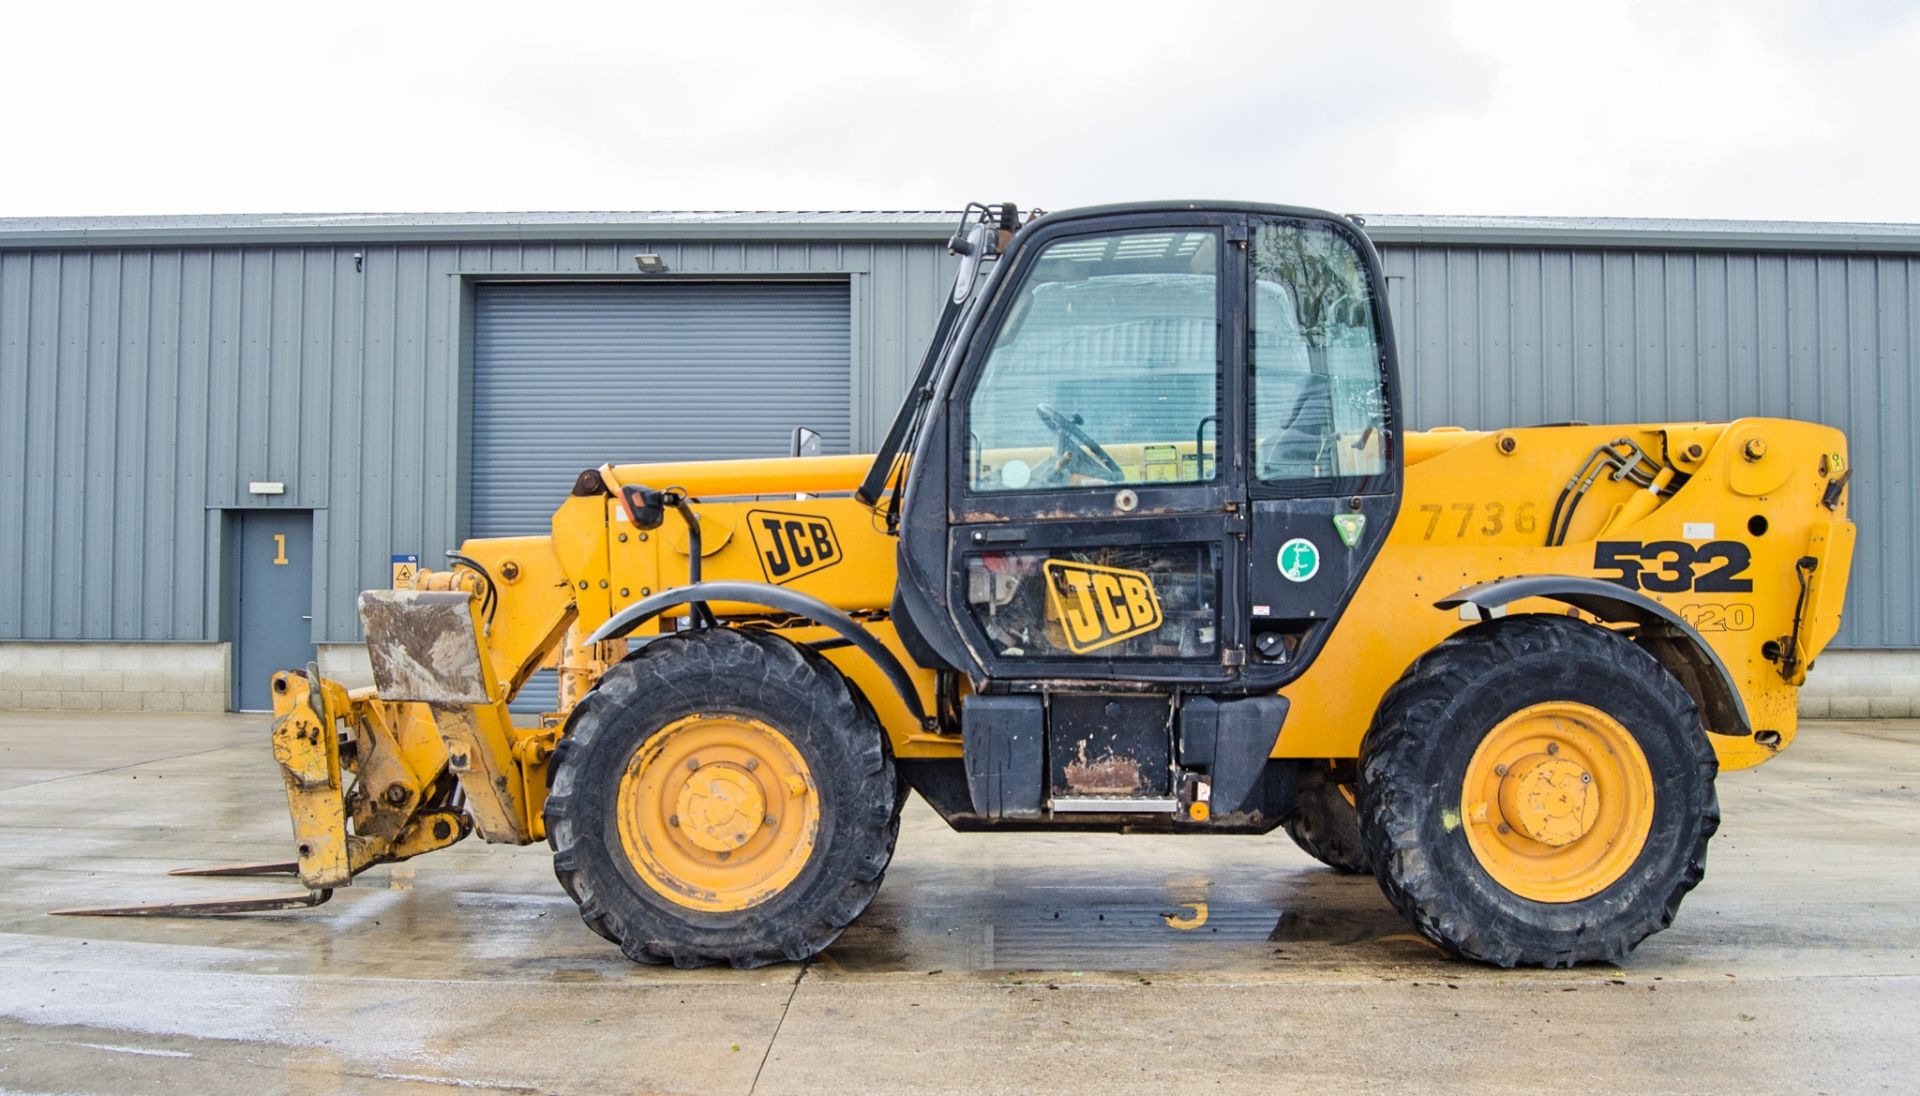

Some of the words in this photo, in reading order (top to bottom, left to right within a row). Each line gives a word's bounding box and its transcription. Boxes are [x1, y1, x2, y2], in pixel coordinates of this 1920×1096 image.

[1420, 501, 1536, 541] 7736
[273, 534, 289, 565] 1
[761, 518, 834, 577] JCB
[1592, 540, 1753, 593] 532
[1064, 569, 1154, 643] JCB
[1680, 603, 1755, 631] 120
